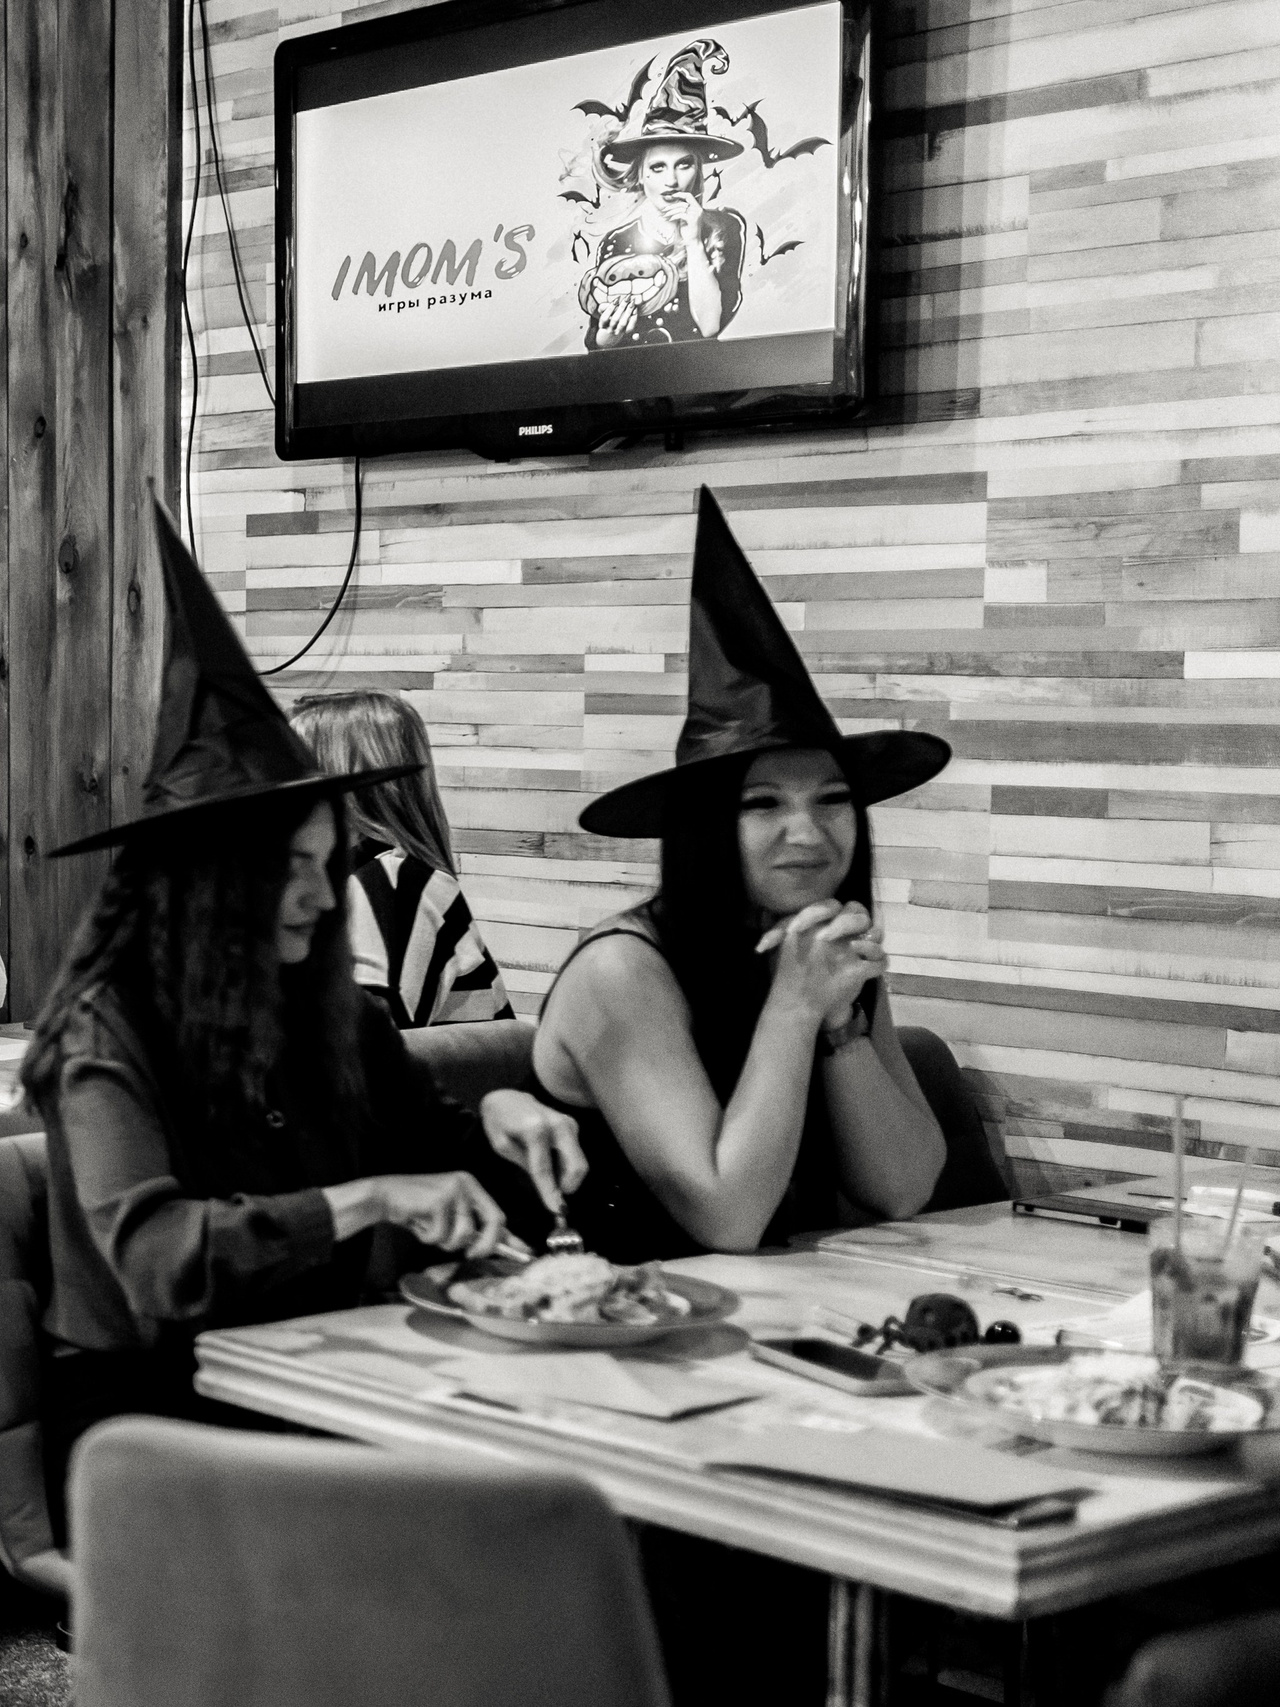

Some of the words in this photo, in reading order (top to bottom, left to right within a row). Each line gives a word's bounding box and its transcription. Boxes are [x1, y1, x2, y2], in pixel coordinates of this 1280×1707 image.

[331, 223, 536, 301] IMOM'S
[378, 298, 420, 313] игры
[427, 289, 493, 309] разума
[518, 424, 554, 436] PHILIPS
